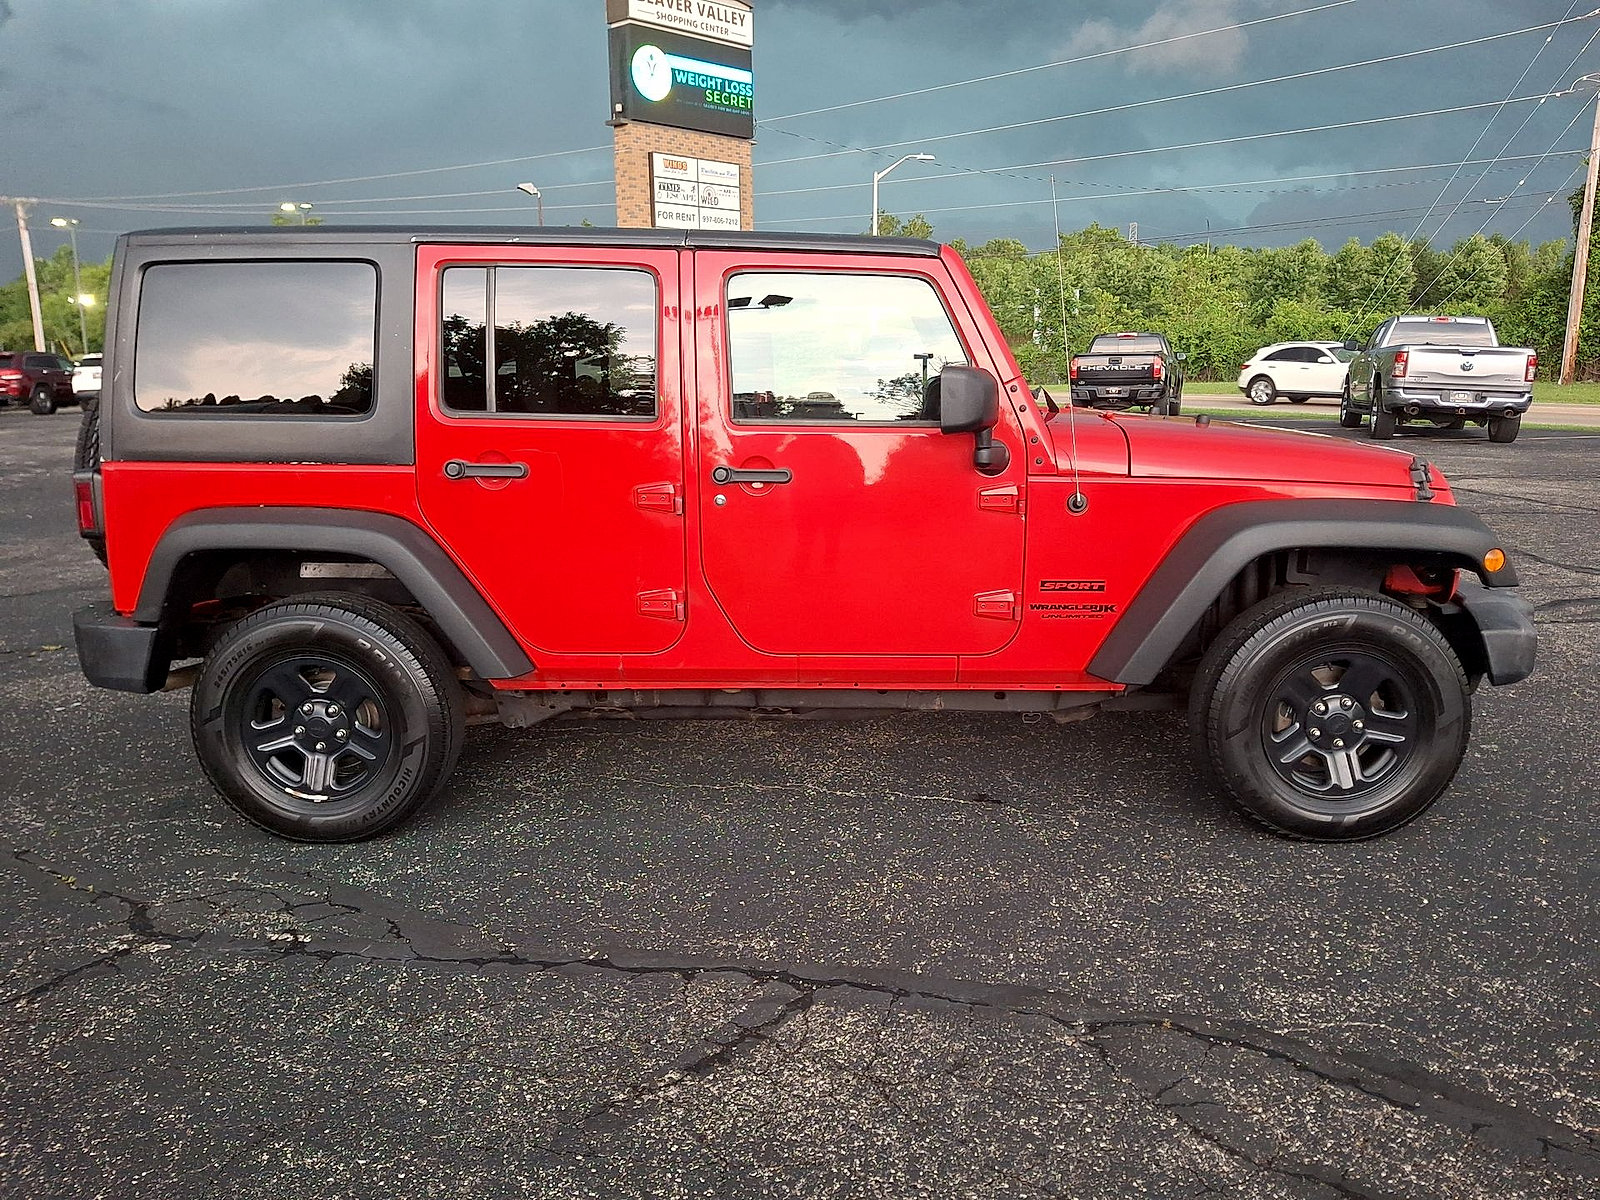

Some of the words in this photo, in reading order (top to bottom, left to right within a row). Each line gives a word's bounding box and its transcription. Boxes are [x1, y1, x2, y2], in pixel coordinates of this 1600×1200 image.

[638, 0, 692, 14] VER
[697, 2, 746, 27] VALLEY
[656, 11, 698, 29] SHOPPING
[700, 22, 729, 36] CENTER
[675, 70, 723, 91] WEIGHT
[725, 80, 753, 97] LOSS
[705, 89, 753, 109] SECRET
[657, 210, 674, 220] FOR
[675, 212, 696, 222] RENT
[1041, 581, 1104, 591] SPORT
[362, 767, 413, 825] HICOUNTRY
